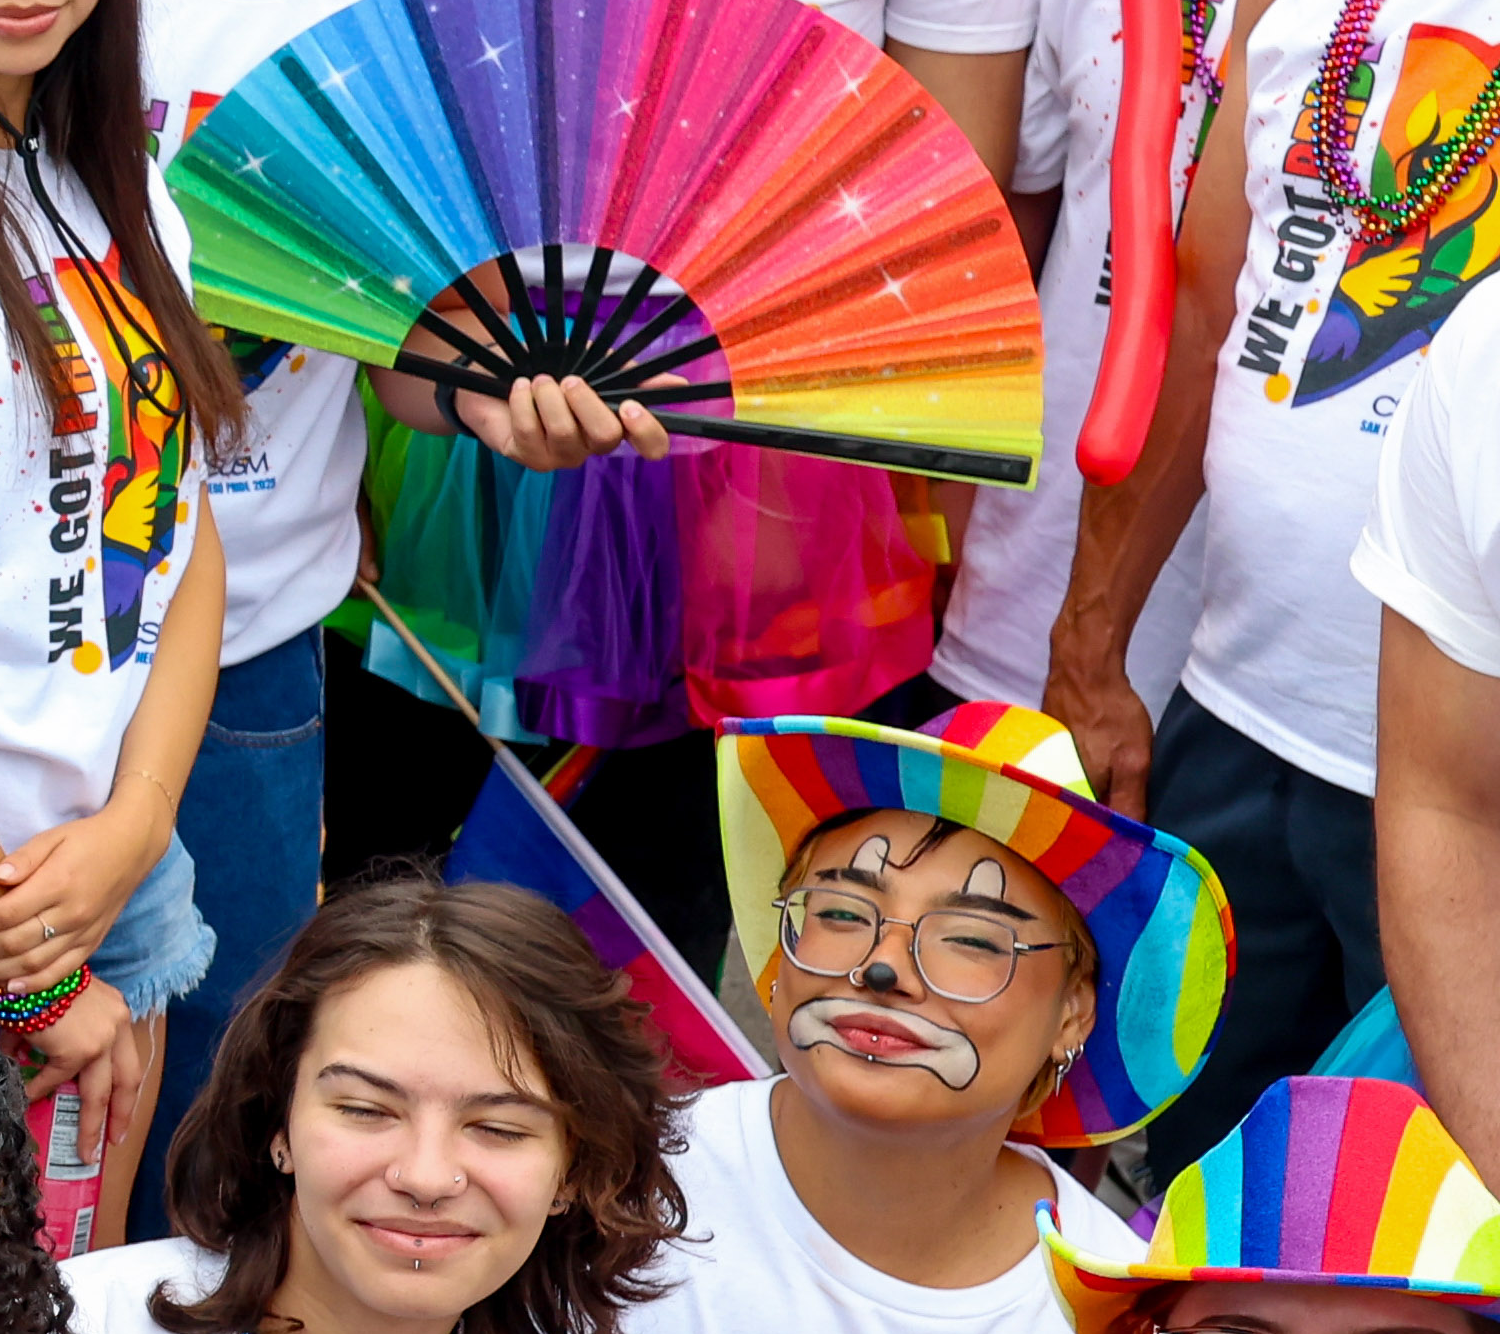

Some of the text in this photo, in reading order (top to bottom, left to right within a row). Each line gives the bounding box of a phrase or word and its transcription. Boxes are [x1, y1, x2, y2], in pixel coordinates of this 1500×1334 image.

[1239, 184, 1340, 376] WE GOT
[48, 449, 96, 664] WE GOT
